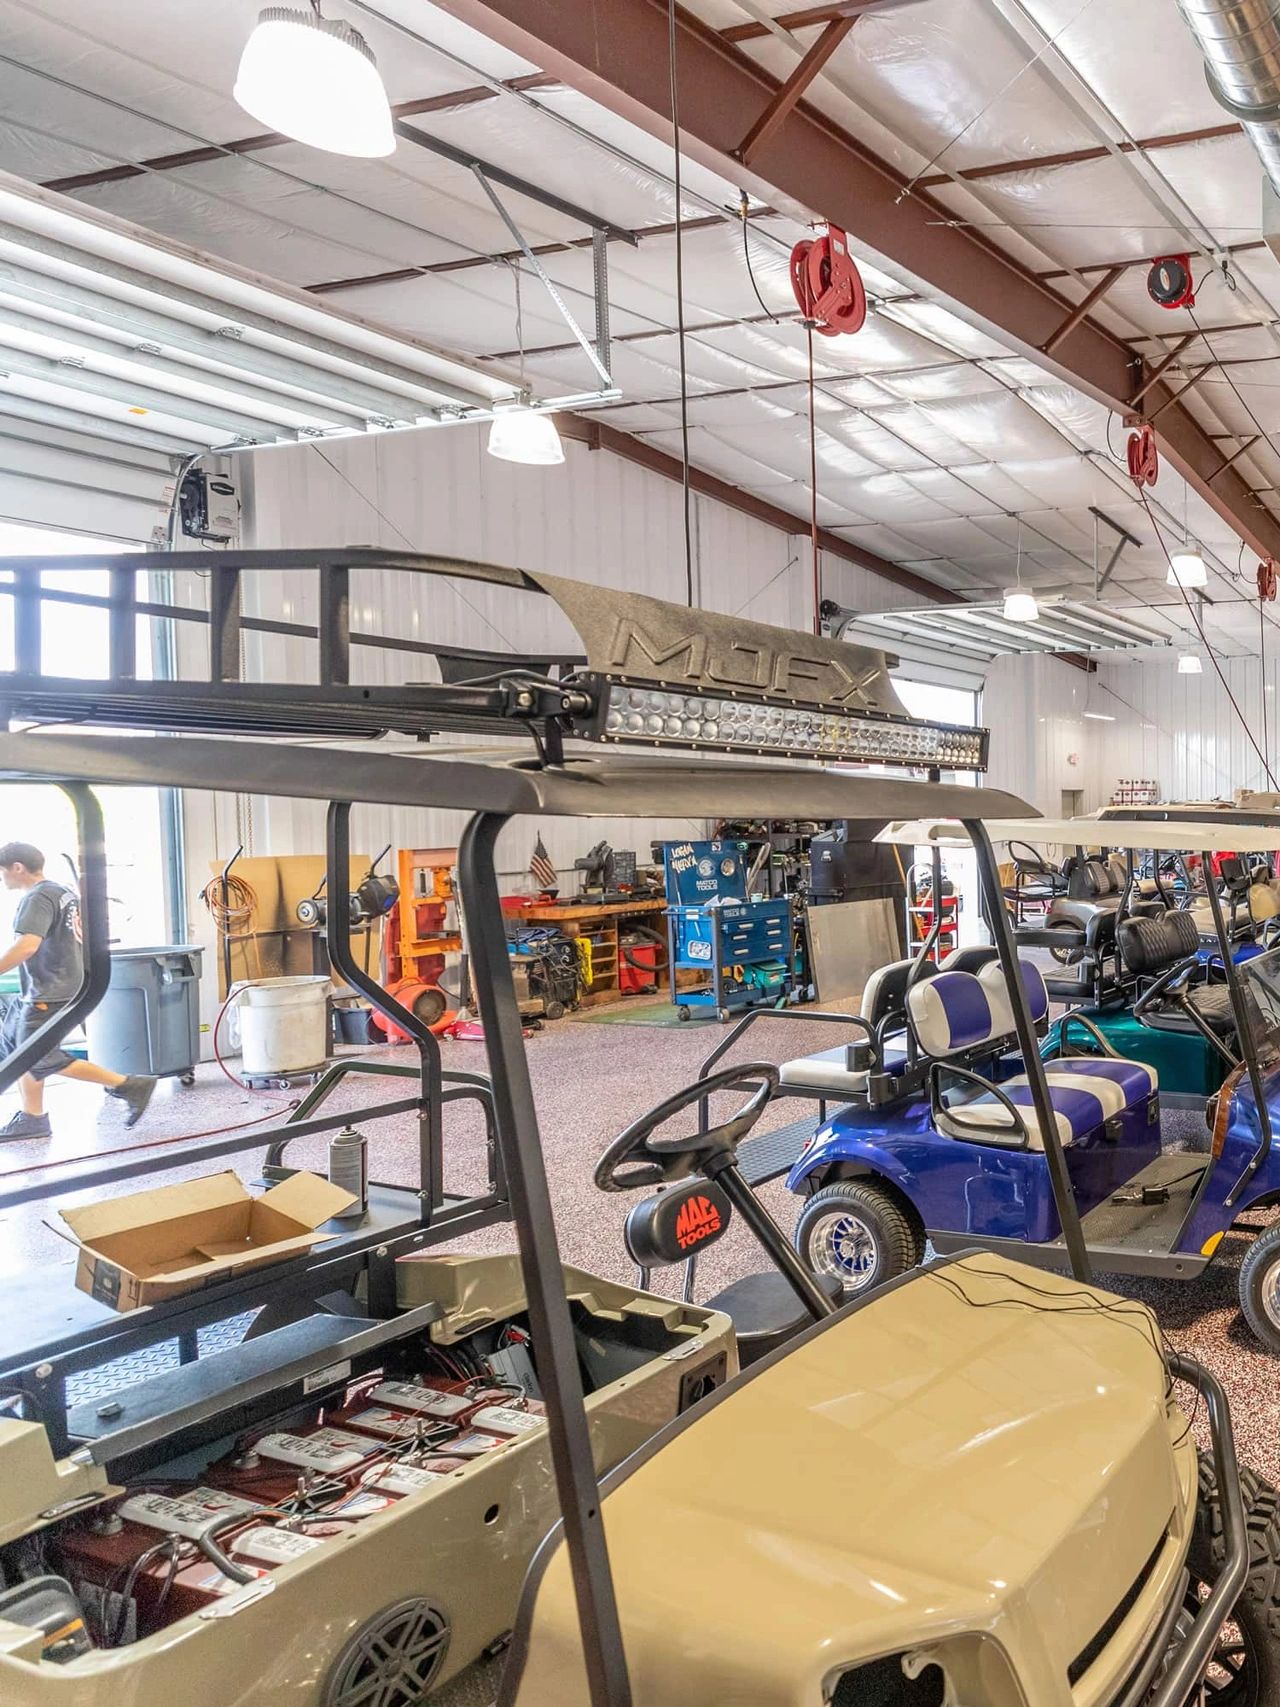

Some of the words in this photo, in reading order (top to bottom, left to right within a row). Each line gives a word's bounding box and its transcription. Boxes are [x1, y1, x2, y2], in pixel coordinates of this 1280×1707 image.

[610, 617, 881, 707] MJFX
[676, 1196, 721, 1239] MAC
[677, 1218, 721, 1249] TOOLS
